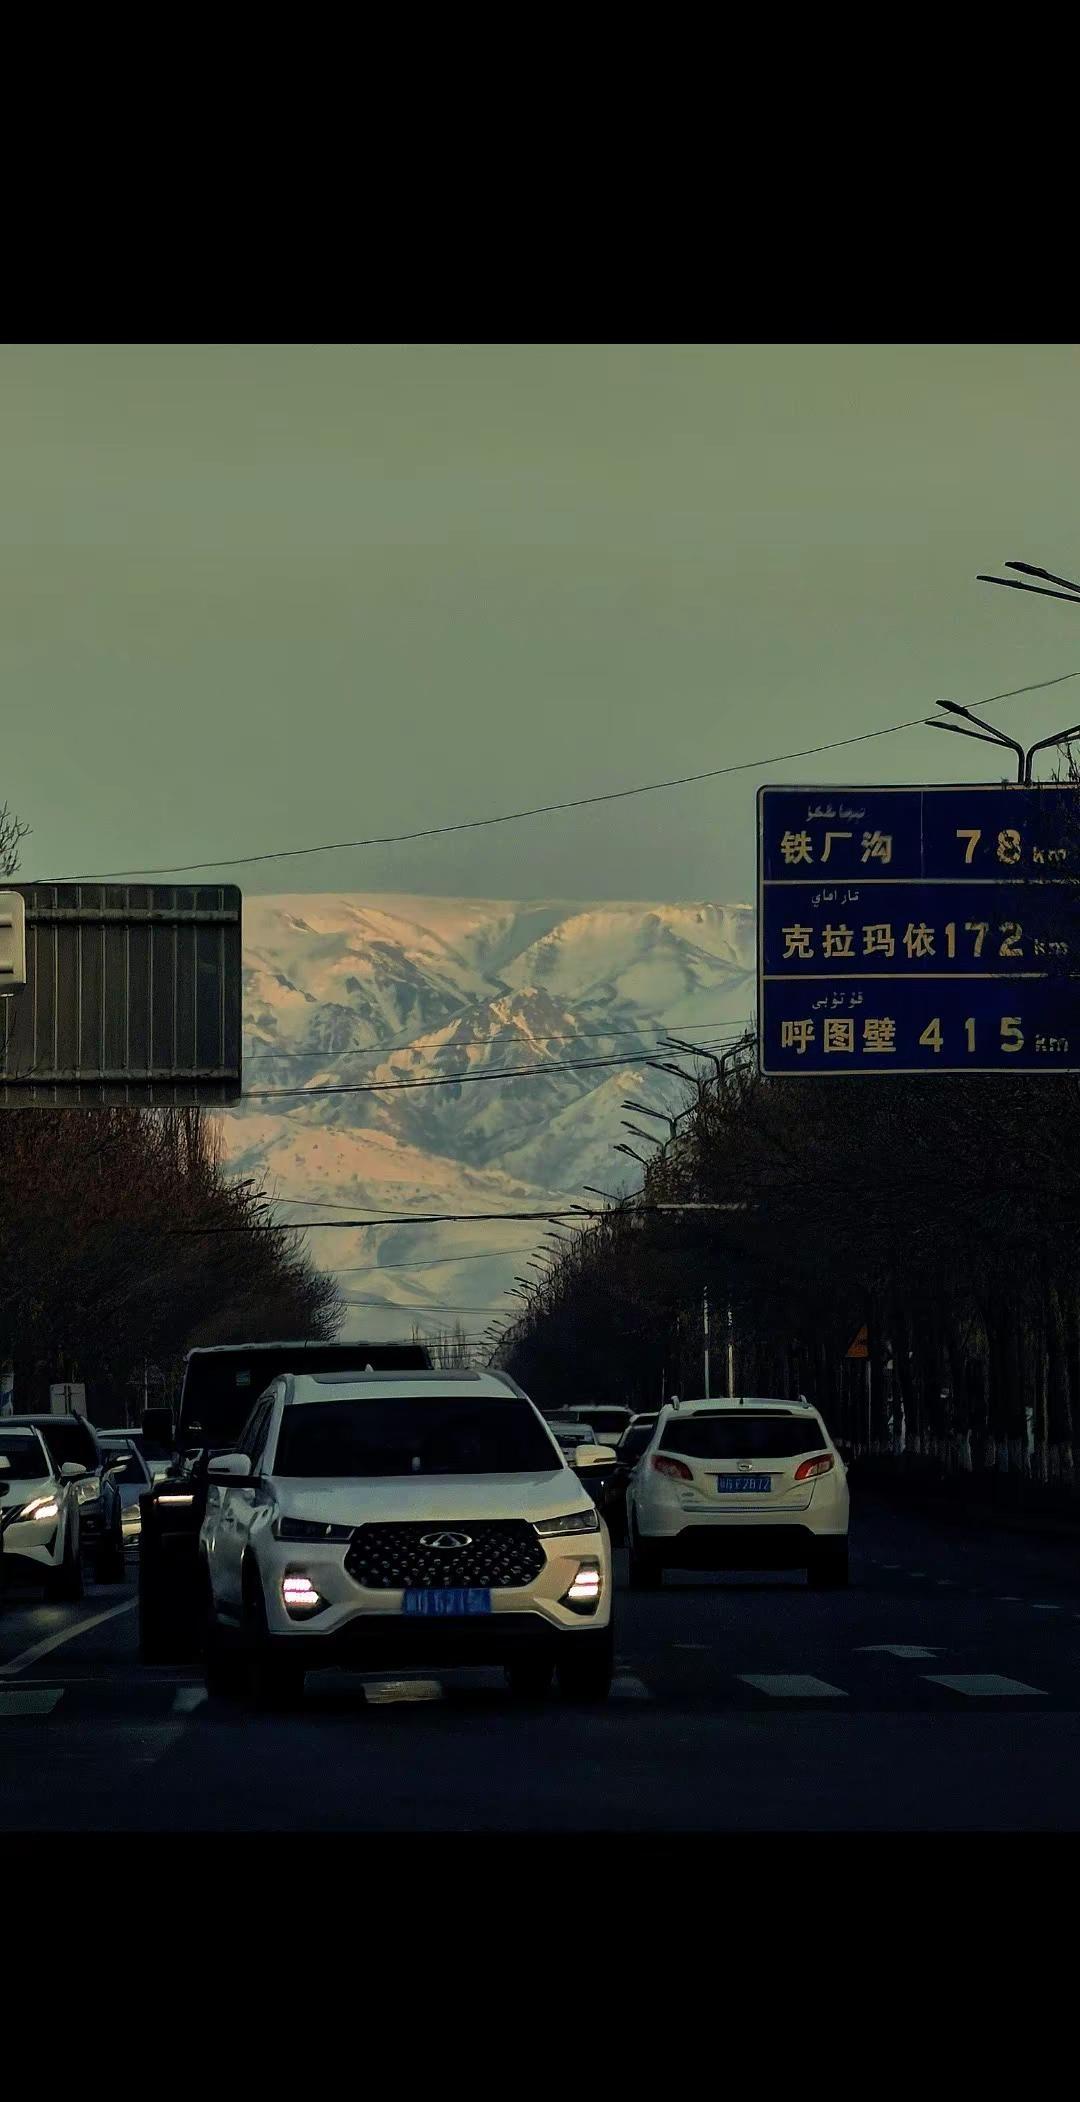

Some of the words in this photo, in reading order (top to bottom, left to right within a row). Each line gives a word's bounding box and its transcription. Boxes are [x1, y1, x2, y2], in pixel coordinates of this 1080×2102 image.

[780, 830, 892, 864] 铁厂沟
[956, 829, 1022, 864] 78
[781, 923, 936, 958] 克拉玛依
[944, 922, 1023, 958] 172
[781, 1016, 897, 1055] 呼图壁
[919, 1016, 1025, 1053] 415
